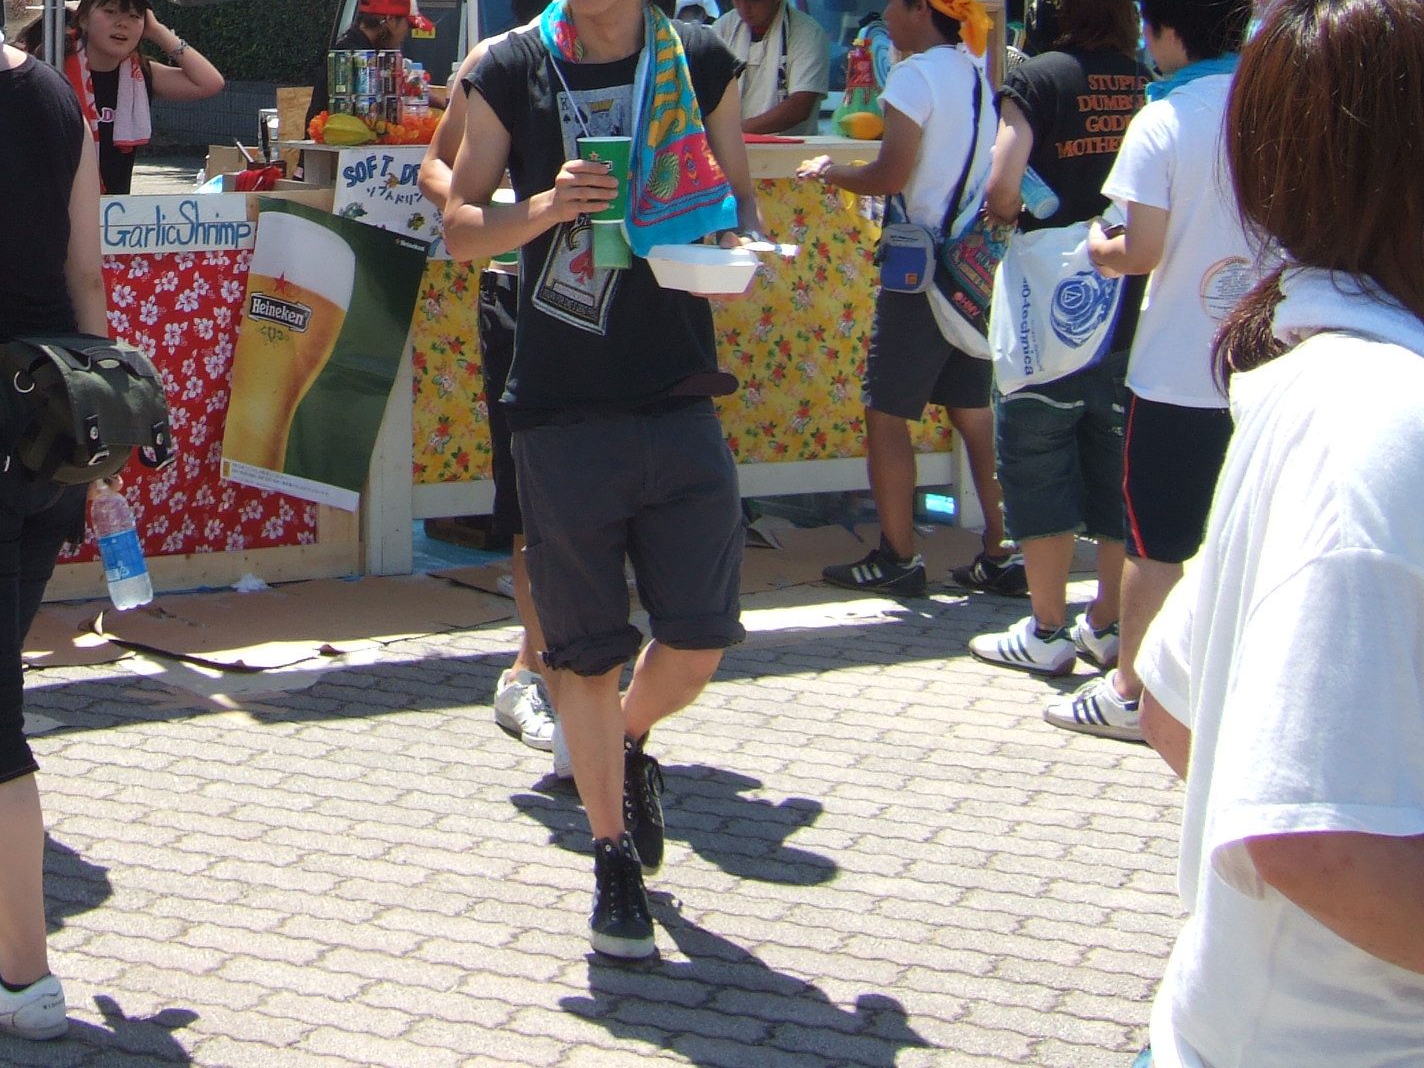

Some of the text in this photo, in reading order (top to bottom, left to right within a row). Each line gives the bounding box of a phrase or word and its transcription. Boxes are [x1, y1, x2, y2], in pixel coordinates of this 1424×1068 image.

[1055, 135, 1123, 160] MOTHE
[342, 154, 395, 189] SOFT
[366, 185, 424, 206] ソフトドリン
[104, 200, 252, 249] Garlic Shrimp
[251, 297, 305, 326] Heineken
